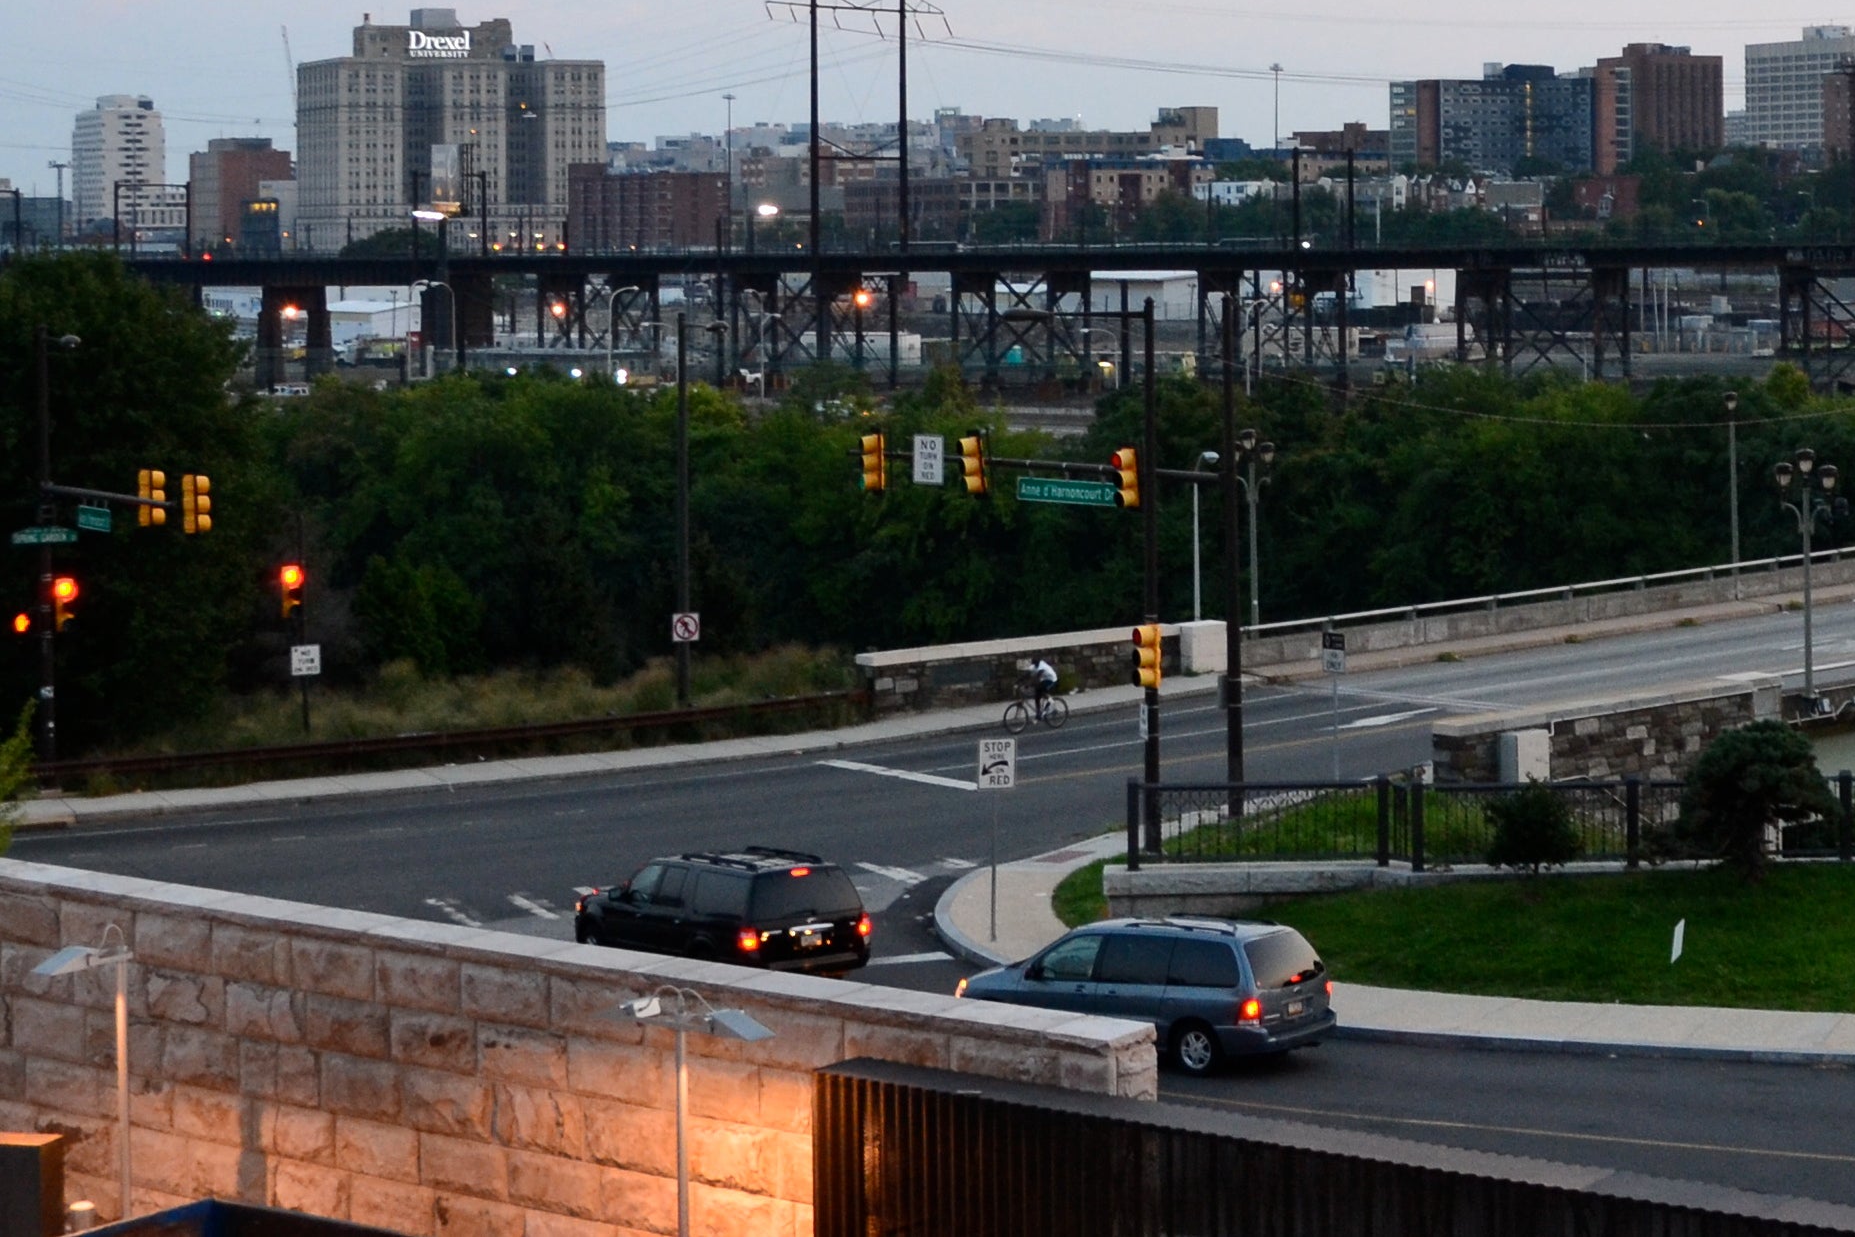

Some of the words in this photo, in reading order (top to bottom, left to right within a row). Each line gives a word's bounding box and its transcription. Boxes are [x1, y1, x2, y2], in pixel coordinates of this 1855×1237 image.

[408, 29, 471, 50] Drexel
[409, 50, 469, 58] UNIVERSITY
[921, 440, 937, 450] NO
[920, 452, 938, 460] TURN
[923, 462, 934, 470] ON
[921, 471, 935, 480] RED
[1021, 483, 1040, 496] Anne
[984, 742, 1011, 752] STOP
[990, 775, 1010, 785] RED
